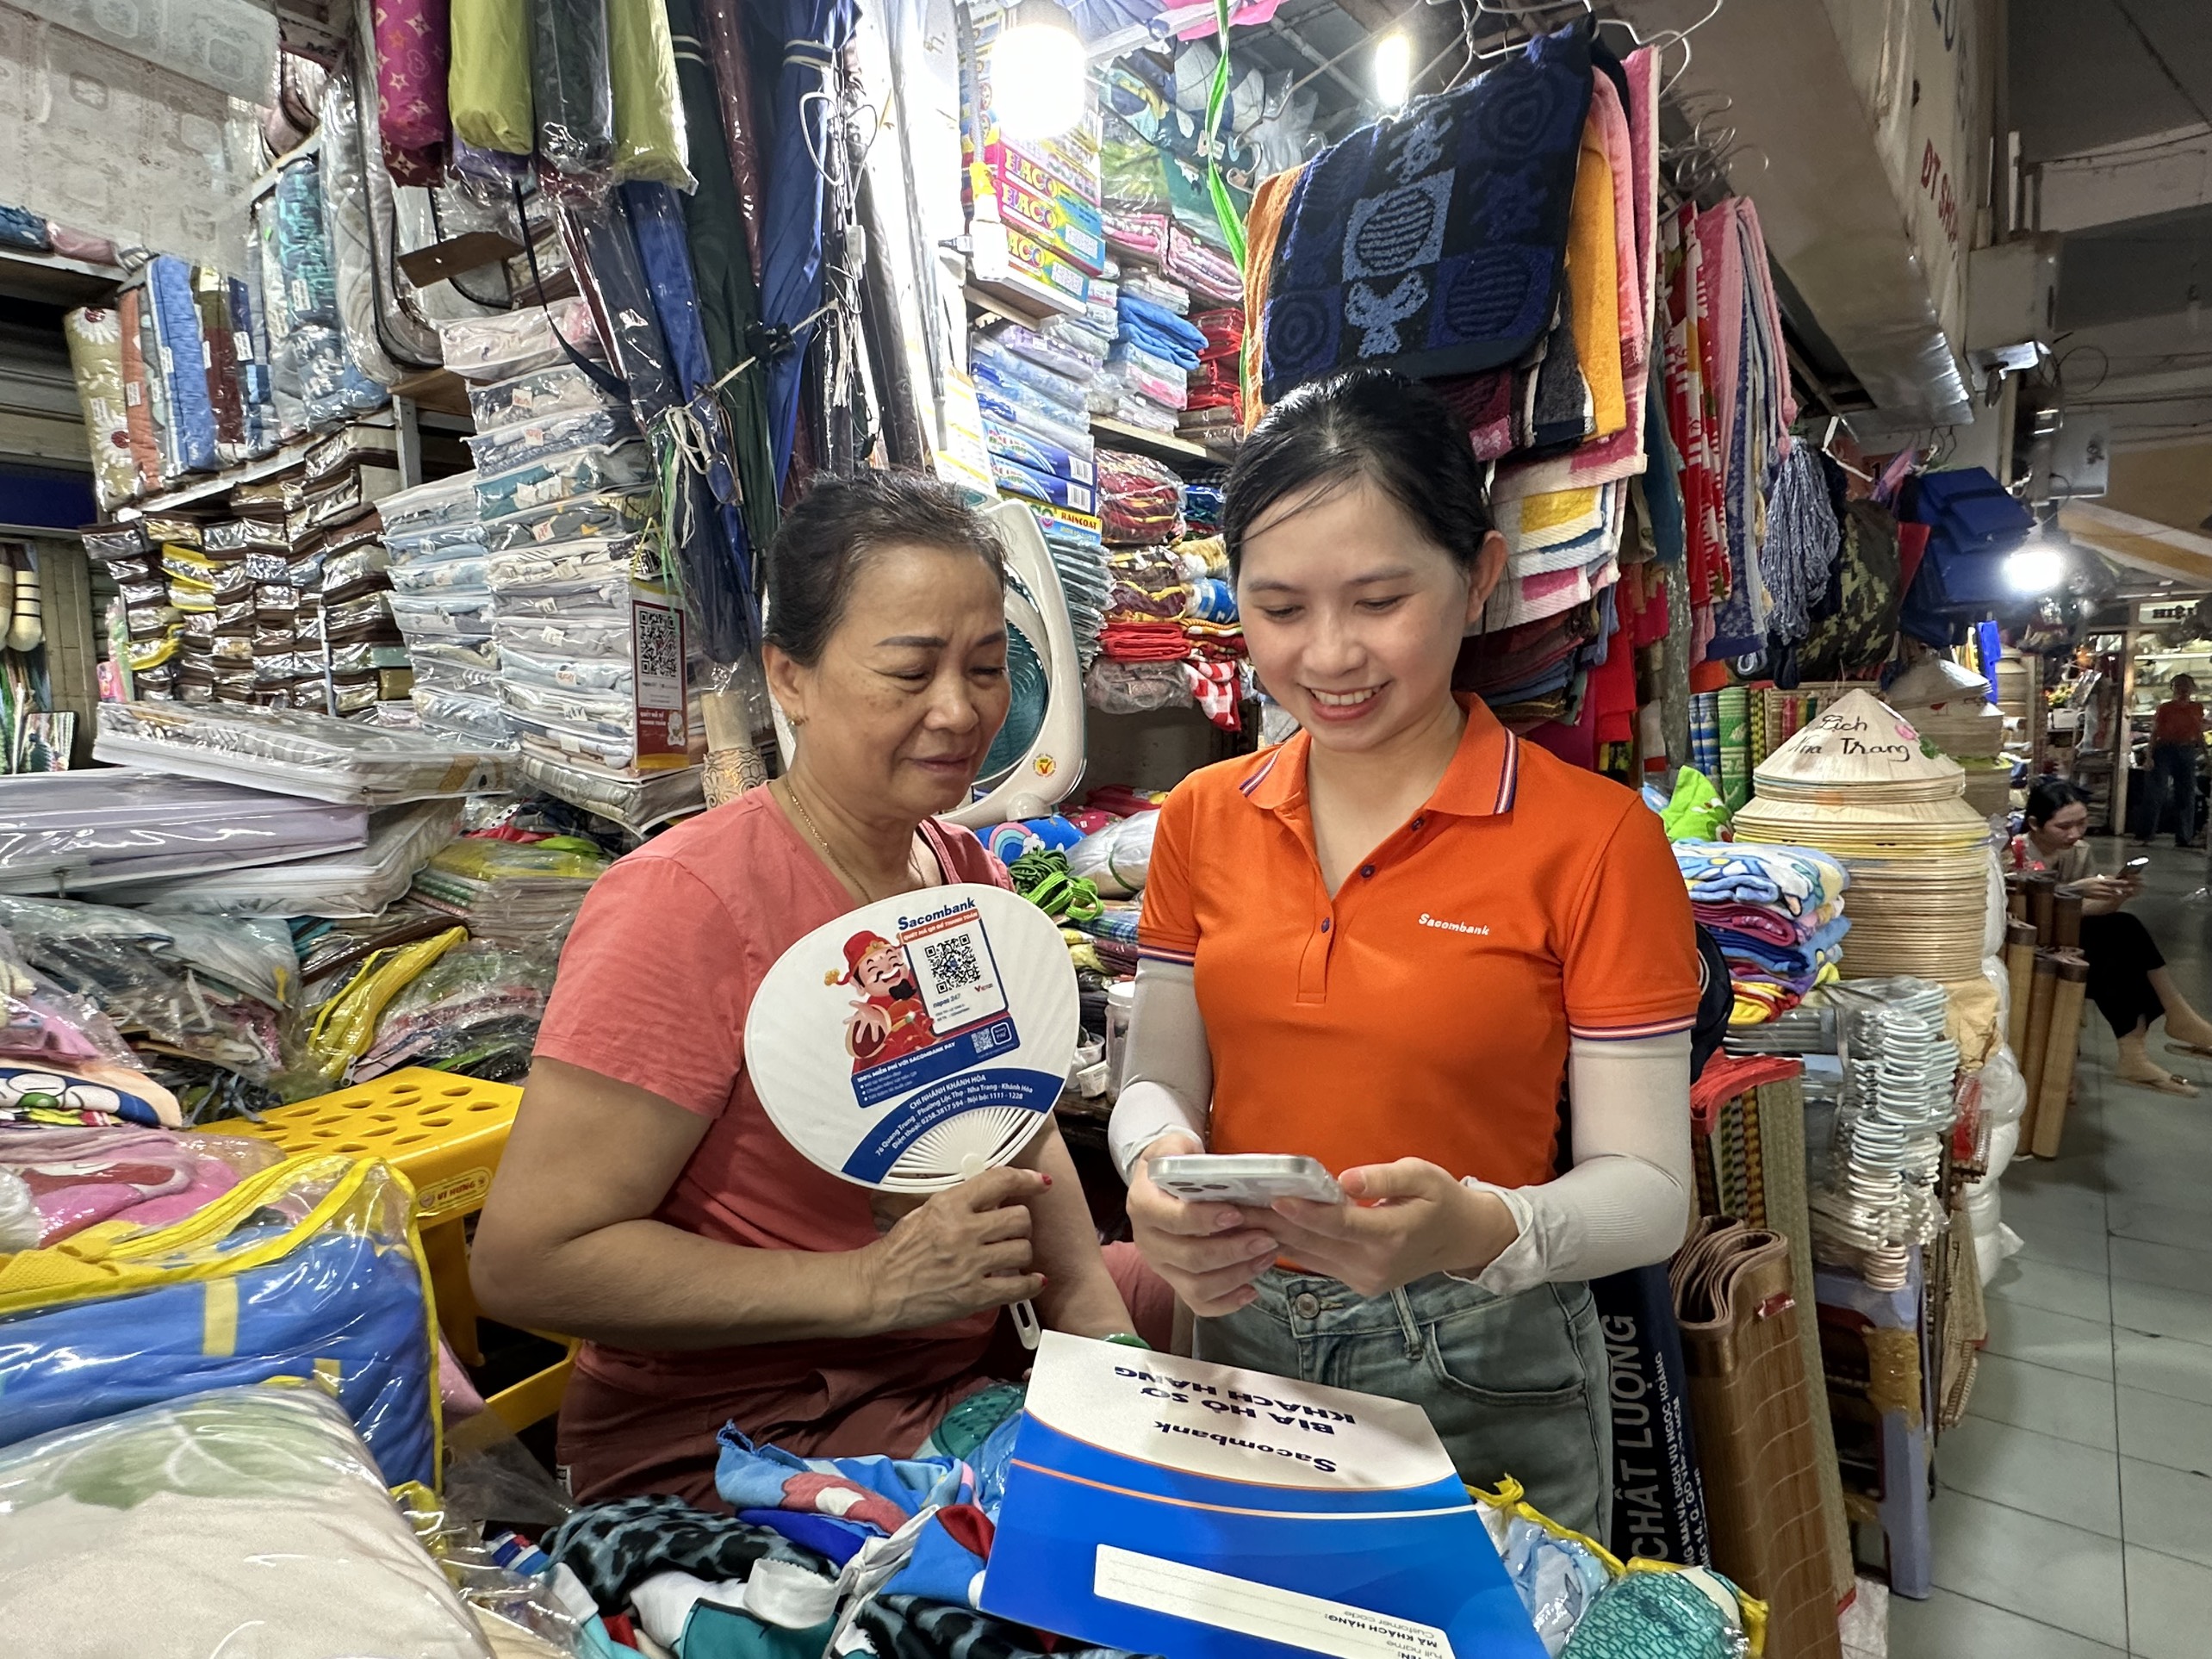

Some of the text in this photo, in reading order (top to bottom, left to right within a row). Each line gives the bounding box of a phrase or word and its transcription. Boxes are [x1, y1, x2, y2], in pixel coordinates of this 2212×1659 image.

[1060, 512, 1097, 530] RAINCOAT
[1841, 737, 1911, 762] Trang
[898, 897, 976, 930] Sacombank
[1419, 913, 1490, 936] Sacombank
[909, 1046, 944, 1064] SACOMBANK
[944, 1041, 956, 1050] PAY
[909, 1098, 923, 1109] CHI
[921, 1084, 947, 1103] NHÁNH
[946, 1076, 971, 1091] KHÁNH
[971, 1074, 987, 1084] HÒA
[875, 1146, 885, 1156] 76
[881, 1128, 901, 1148] Quang
[897, 1115, 916, 1131] Trung
[916, 1097, 941, 1115] Phường
[941, 1094, 952, 1103] Lộc
[951, 1090, 964, 1099] Thọ
[966, 1085, 980, 1094] Nha
[1001, 1083, 1021, 1091] Khánh
[1021, 1085, 1034, 1094] Hòa
[892, 1135, 907, 1149] Điện
[966, 1095, 979, 1103] Nội
[990, 1091, 1004, 1100] 1111
[1655, 1351, 1669, 1402] HOÀNG
[1115, 1366, 1357, 1425] KHÁCH HÀNG
[1140, 1386, 1335, 1435] BÌA HỒ SƠ
[1662, 1402, 1676, 1444] NGỌC
[1153, 1420, 1337, 1473] Sacombank
[1325, 1613, 1438, 1649] MÃ KHÁCH HÀNG:
[1344, 1610, 1435, 1640] Customer code
[1386, 1640, 1422, 1655] name
